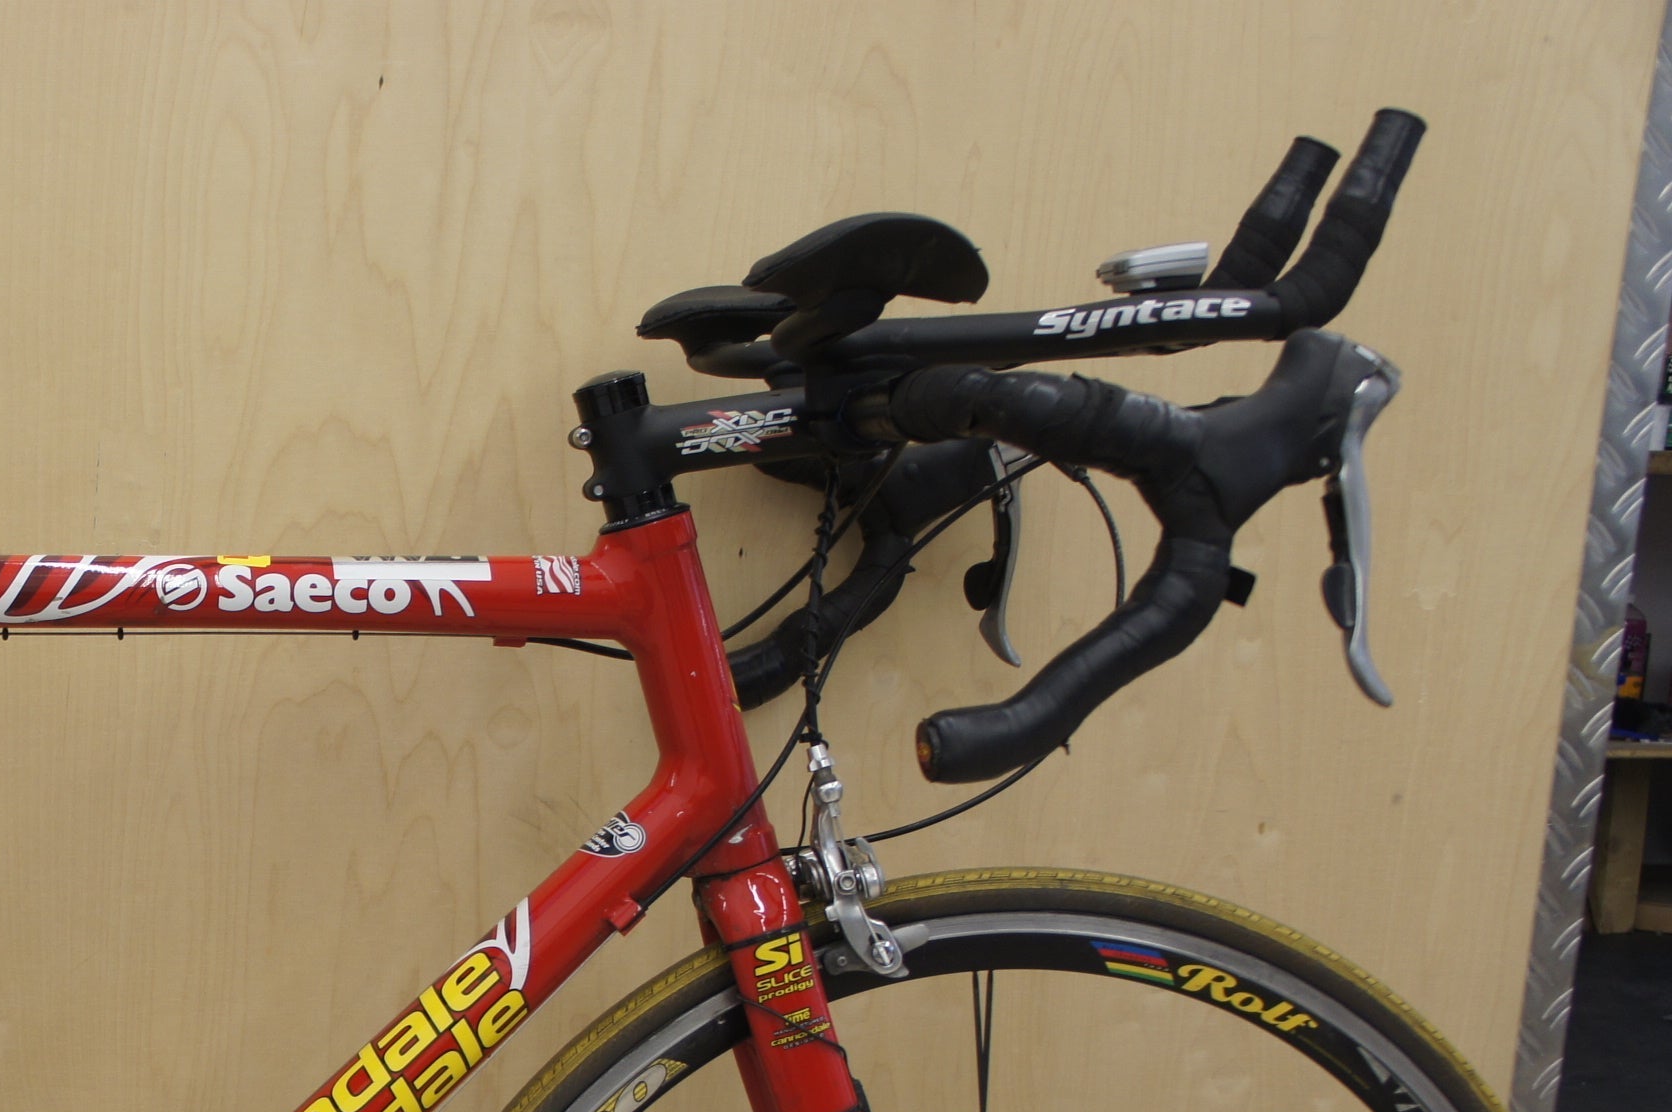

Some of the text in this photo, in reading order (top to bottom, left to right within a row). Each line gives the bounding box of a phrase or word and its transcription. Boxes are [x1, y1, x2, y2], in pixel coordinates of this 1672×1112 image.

[1033, 297, 1252, 340] Syntace
[217, 563, 412, 615] Saeco
[755, 932, 805, 978] Si
[756, 965, 814, 992] SLICE
[758, 979, 815, 1004] prodigy
[1177, 964, 1320, 1032] Rolf
[771, 1022, 831, 1047] cannodale
